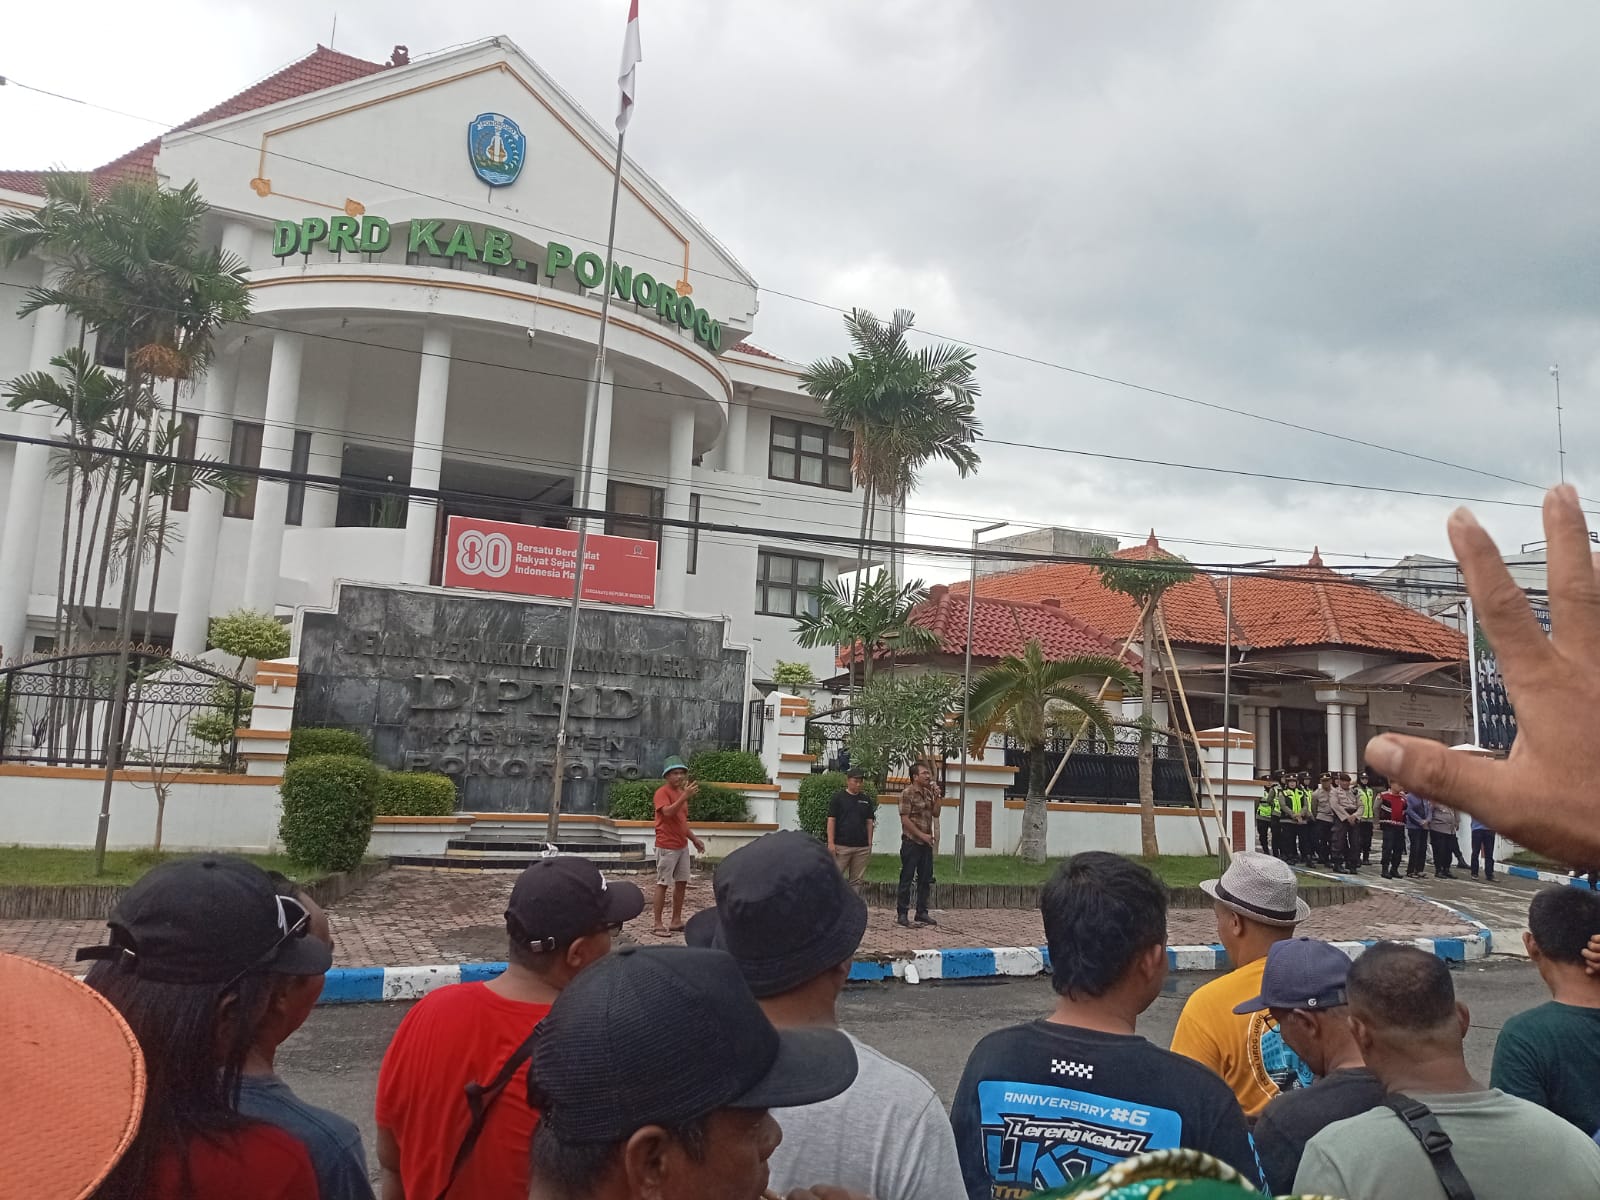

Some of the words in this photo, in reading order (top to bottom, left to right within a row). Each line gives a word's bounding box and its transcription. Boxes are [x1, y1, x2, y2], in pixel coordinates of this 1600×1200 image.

[272, 215, 391, 258] DPRD
[407, 218, 527, 271] KAB.
[545, 241, 723, 351] PONOROGO
[456, 529, 512, 578] 80
[515, 553, 549, 567] Rakyat
[551, 558, 595, 571] Sejahra
[516, 542, 554, 555] Bersatu
[555, 547, 600, 561] Berdulat
[514, 564, 561, 578] Indonesia
[411, 673, 643, 719] DPRD
[405, 752, 642, 781] PONOROGO
[1004, 1092, 1110, 1118] ANNIVERSARY
[1110, 1107, 1150, 1127] #6
[1013, 1122, 1082, 1142] Lereng
[1081, 1130, 1136, 1152] Kelud
